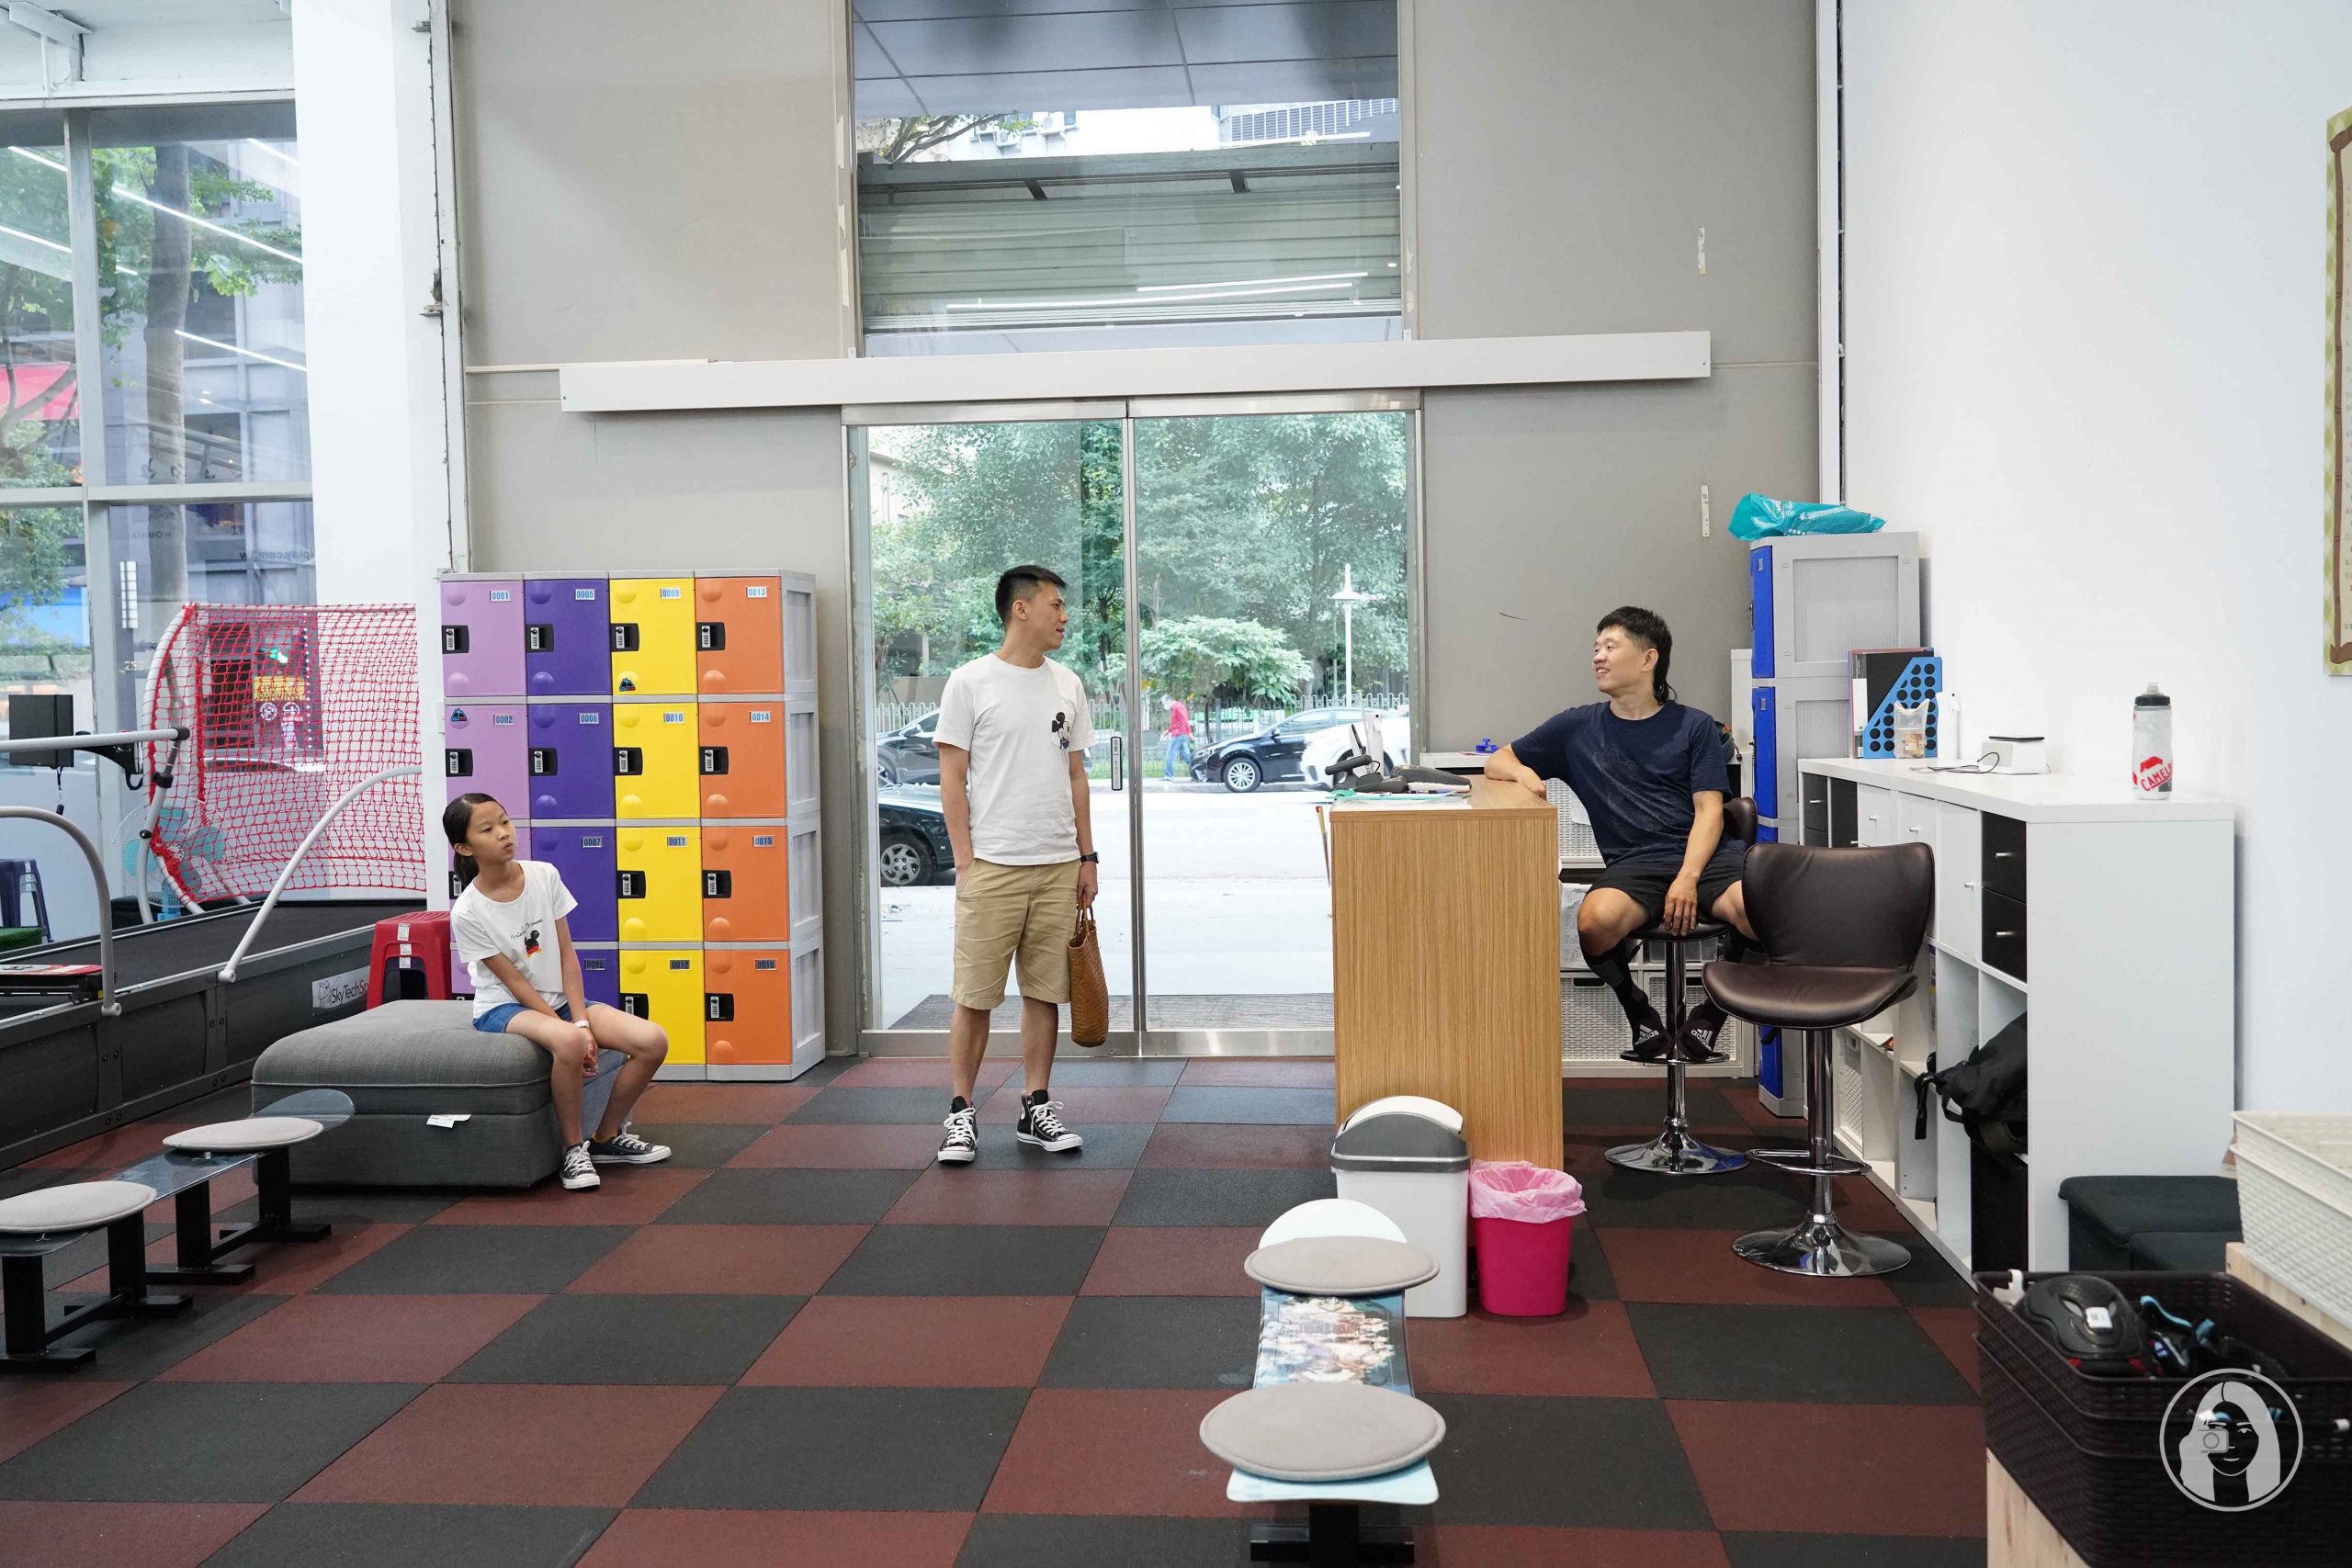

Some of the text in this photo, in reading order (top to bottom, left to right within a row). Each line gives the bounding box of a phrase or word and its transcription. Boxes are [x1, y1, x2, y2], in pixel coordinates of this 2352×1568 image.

[492, 592, 508, 600] 0001
[577, 591, 594, 599] 0005
[662, 590, 679, 598] 0009
[749, 589, 765, 597] 0013
[495, 716, 513, 724] 0002
[666, 714, 683, 722] 0010
[752, 713, 769, 721] 0014
[583, 838, 600, 846] 0007
[669, 837, 685, 845] 0011
[755, 837, 773, 845] 0015
